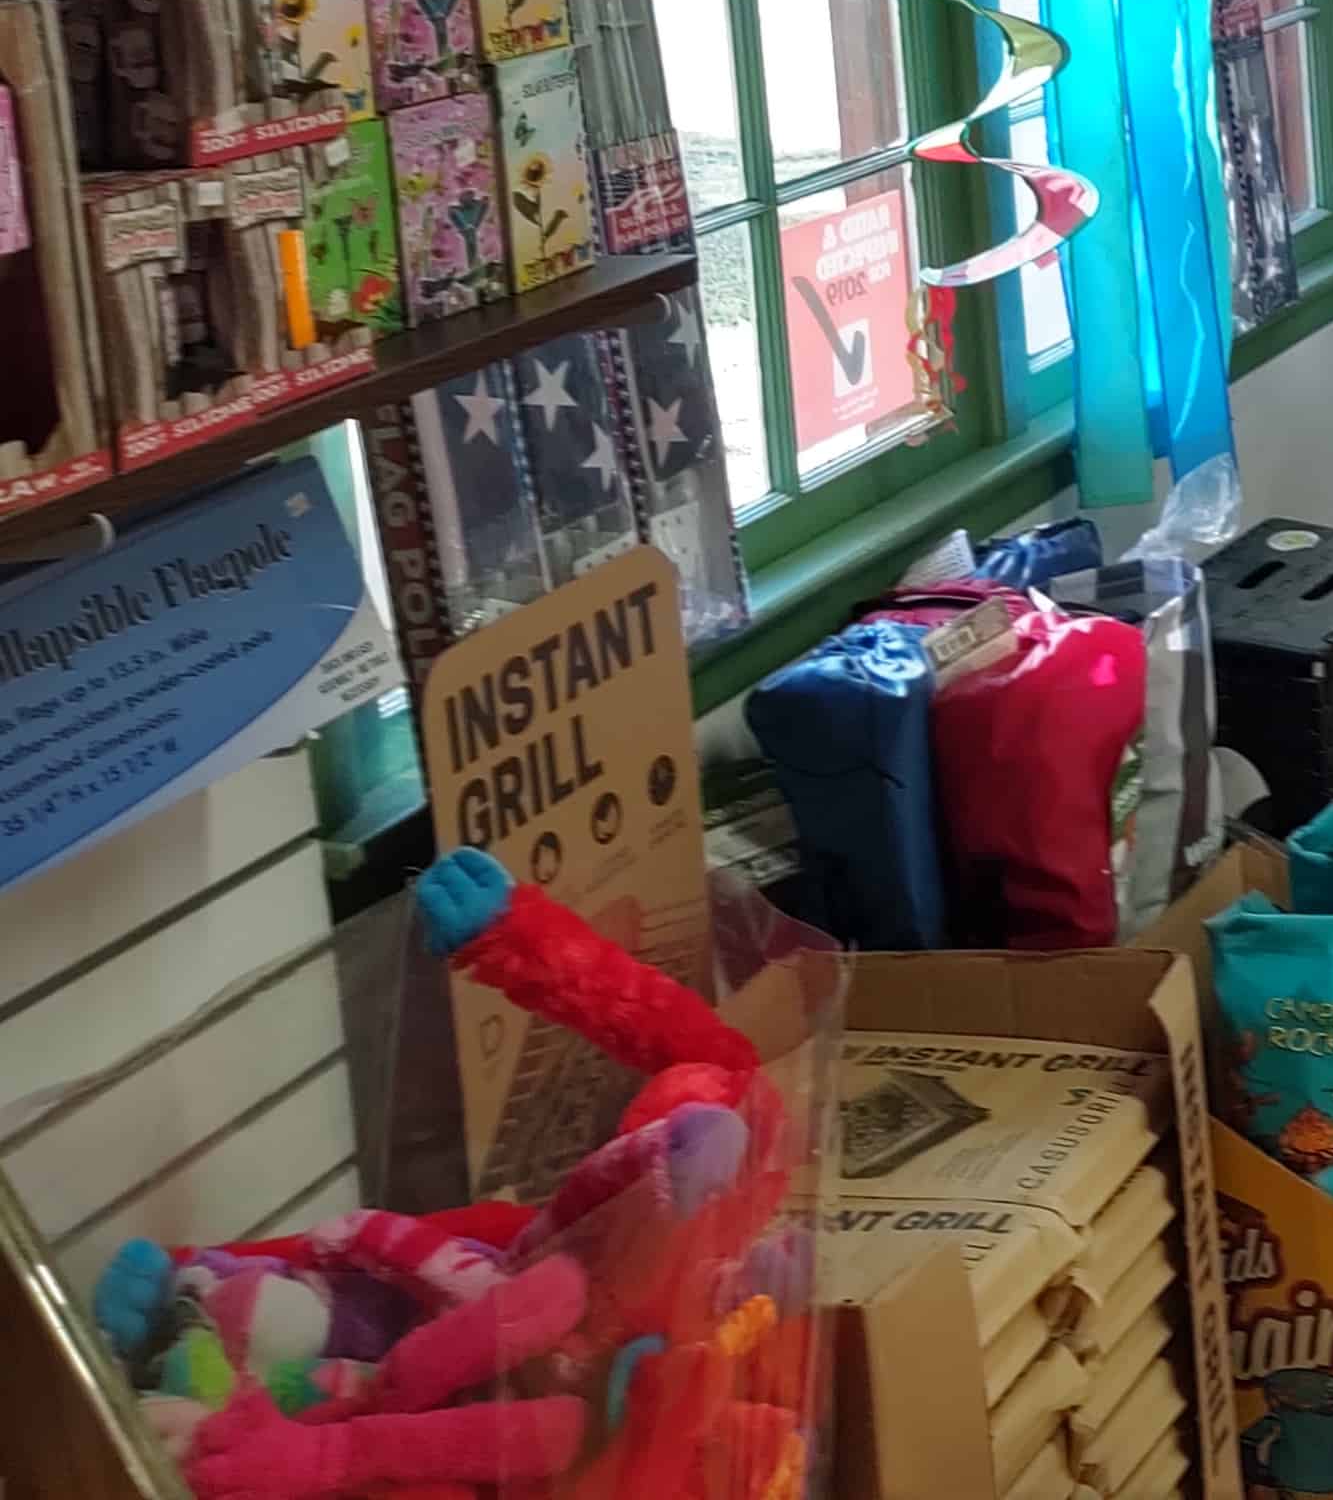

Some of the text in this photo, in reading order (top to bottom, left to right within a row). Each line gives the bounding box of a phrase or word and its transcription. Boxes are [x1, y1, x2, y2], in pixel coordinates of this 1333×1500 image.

[152, 523, 293, 609] Flagpole
[443, 581, 657, 775] INSTANT
[458, 714, 604, 851] GRILL
[855, 1045, 1152, 1077] INSTANT GRILL
[893, 1209, 1015, 1235] GRILL
